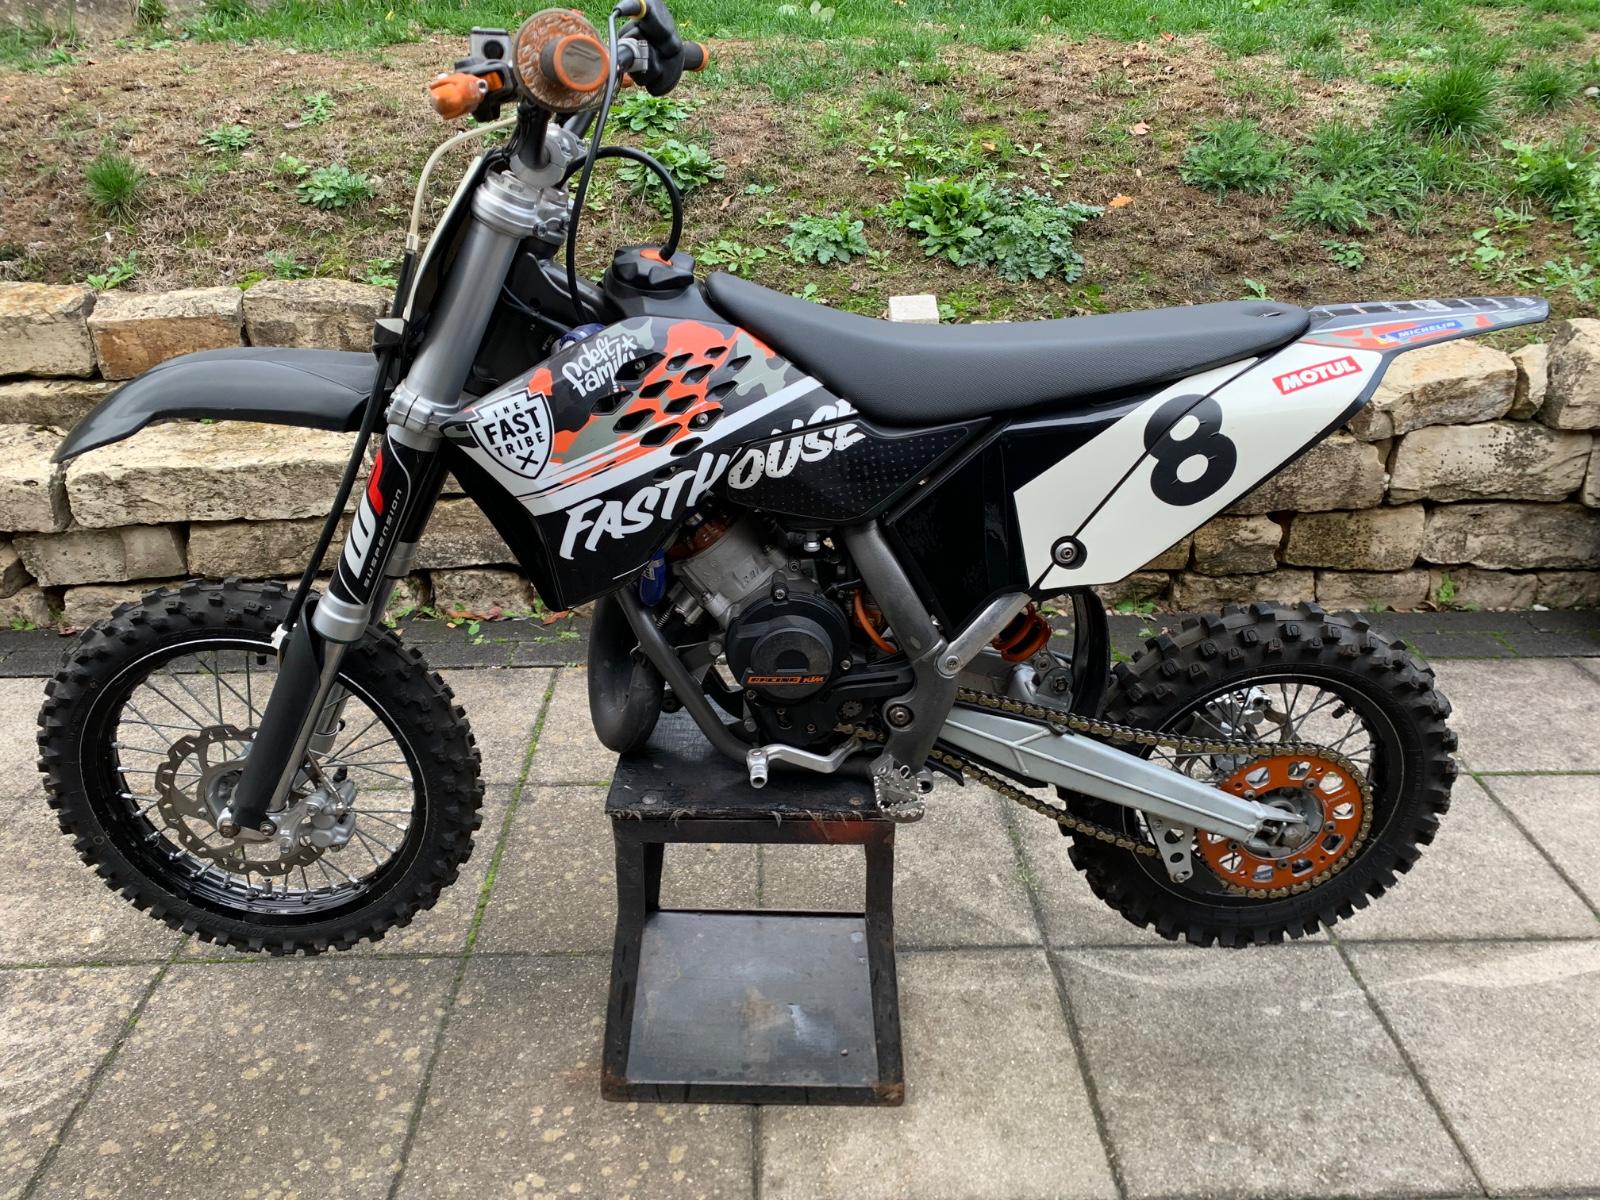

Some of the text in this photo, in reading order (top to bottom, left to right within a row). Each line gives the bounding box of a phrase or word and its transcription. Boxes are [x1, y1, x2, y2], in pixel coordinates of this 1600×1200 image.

[1397, 321, 1456, 338] MICHELIN
[578, 336, 620, 371] deft
[1279, 357, 1357, 394] MOTUL
[483, 406, 541, 446] FAST
[493, 402, 521, 418] THE
[494, 431, 545, 457] TRIBE
[1143, 394, 1237, 506] 8
[558, 399, 867, 560] FASTHOUSE
[363, 488, 402, 589] SUSPENSION
